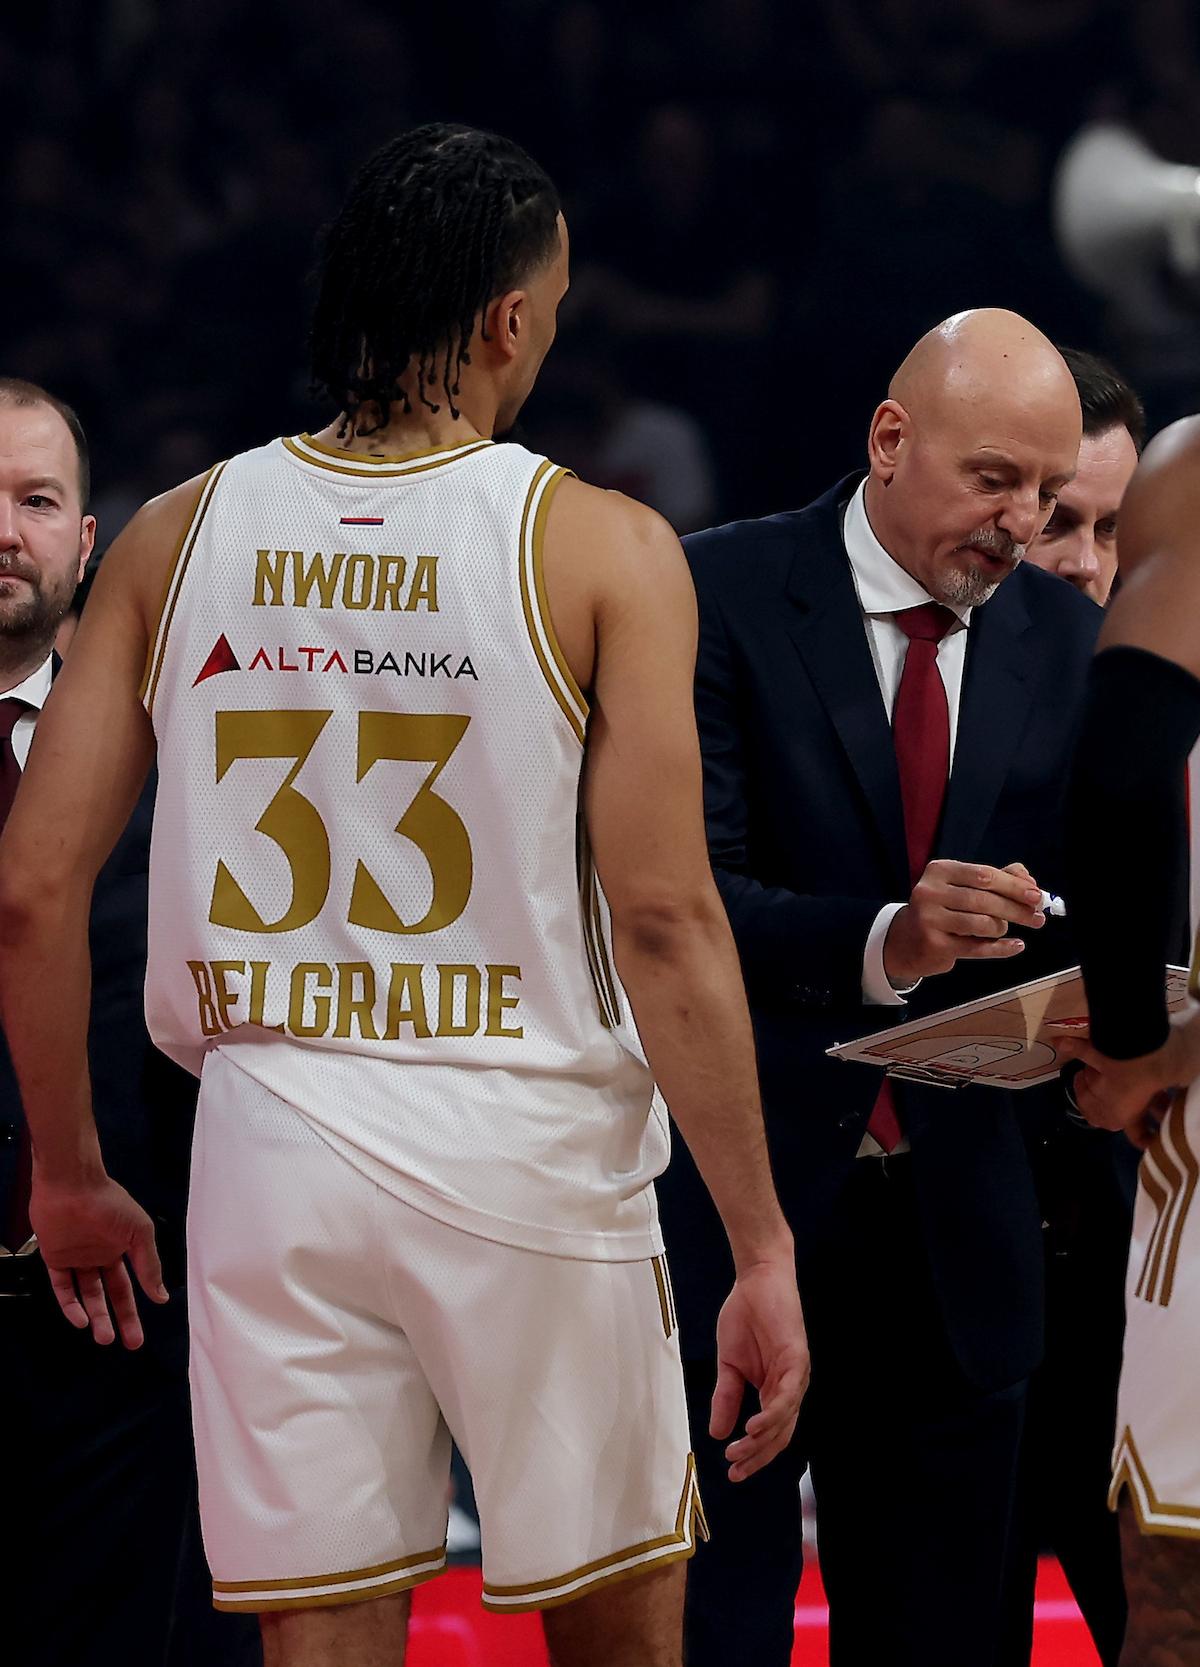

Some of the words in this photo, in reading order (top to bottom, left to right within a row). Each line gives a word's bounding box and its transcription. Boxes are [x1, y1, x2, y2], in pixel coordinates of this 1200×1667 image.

[252, 550, 440, 613] NWORA
[208, 709, 474, 935] 33
[187, 959, 524, 1040] BELGRADE
